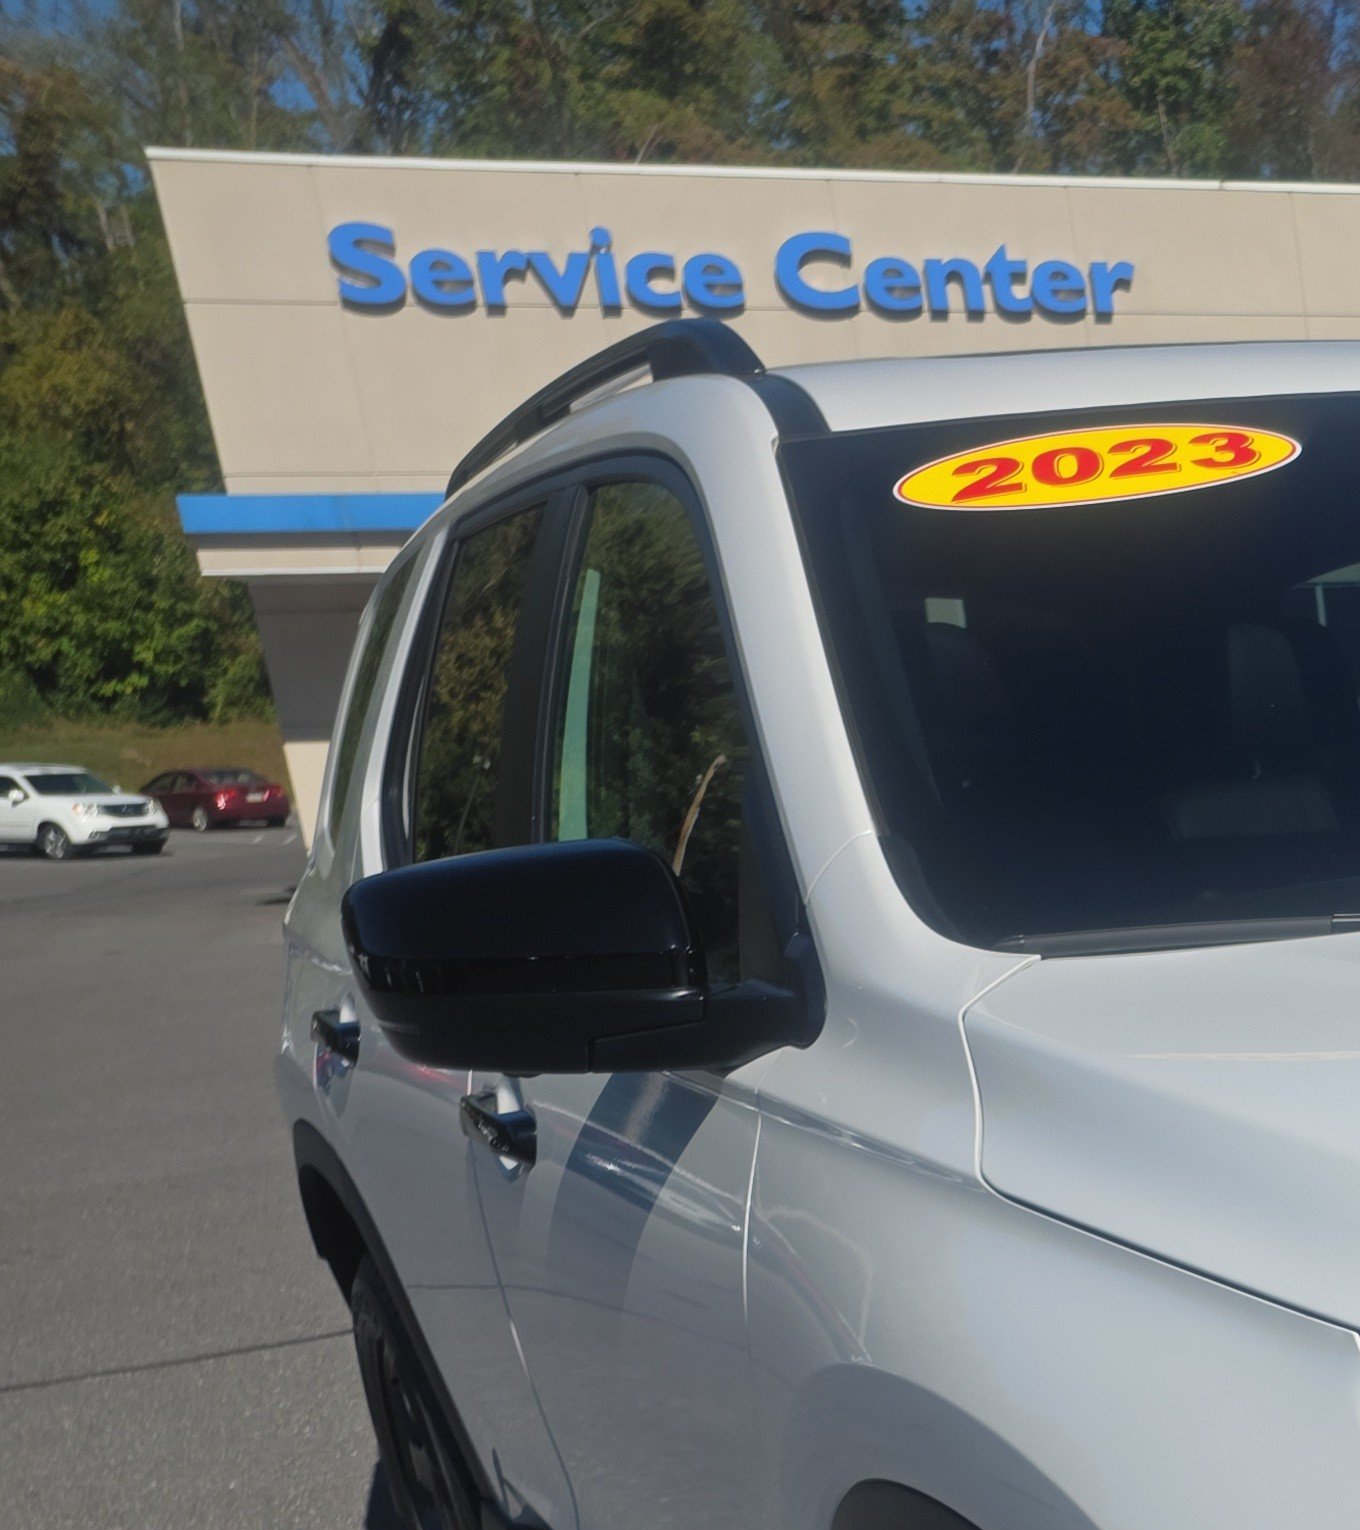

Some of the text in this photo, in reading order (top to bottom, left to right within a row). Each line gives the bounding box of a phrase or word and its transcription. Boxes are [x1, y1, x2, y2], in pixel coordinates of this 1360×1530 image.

[327, 220, 1136, 324] Service Center
[950, 431, 1263, 503] 2023
